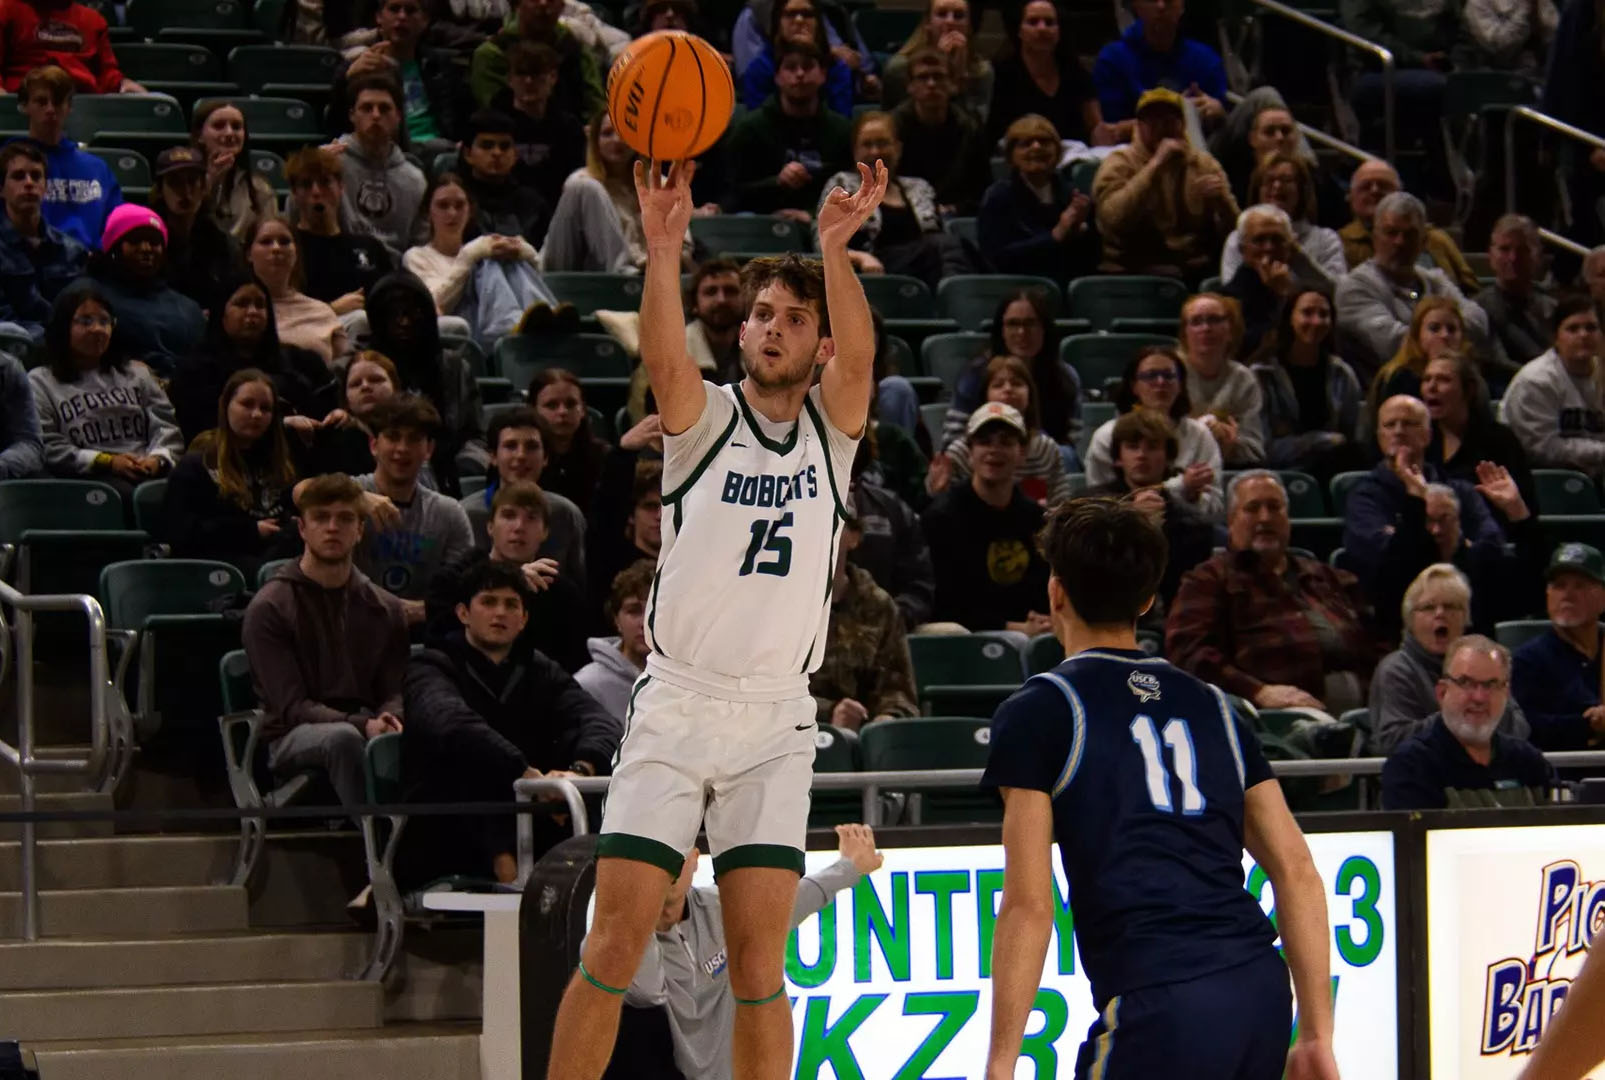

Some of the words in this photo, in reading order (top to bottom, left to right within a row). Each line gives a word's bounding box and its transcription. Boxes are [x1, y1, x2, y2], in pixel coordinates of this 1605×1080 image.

[739, 512, 794, 577] 15
[1129, 713, 1206, 815] 11
[789, 988, 1069, 1080] KZR
